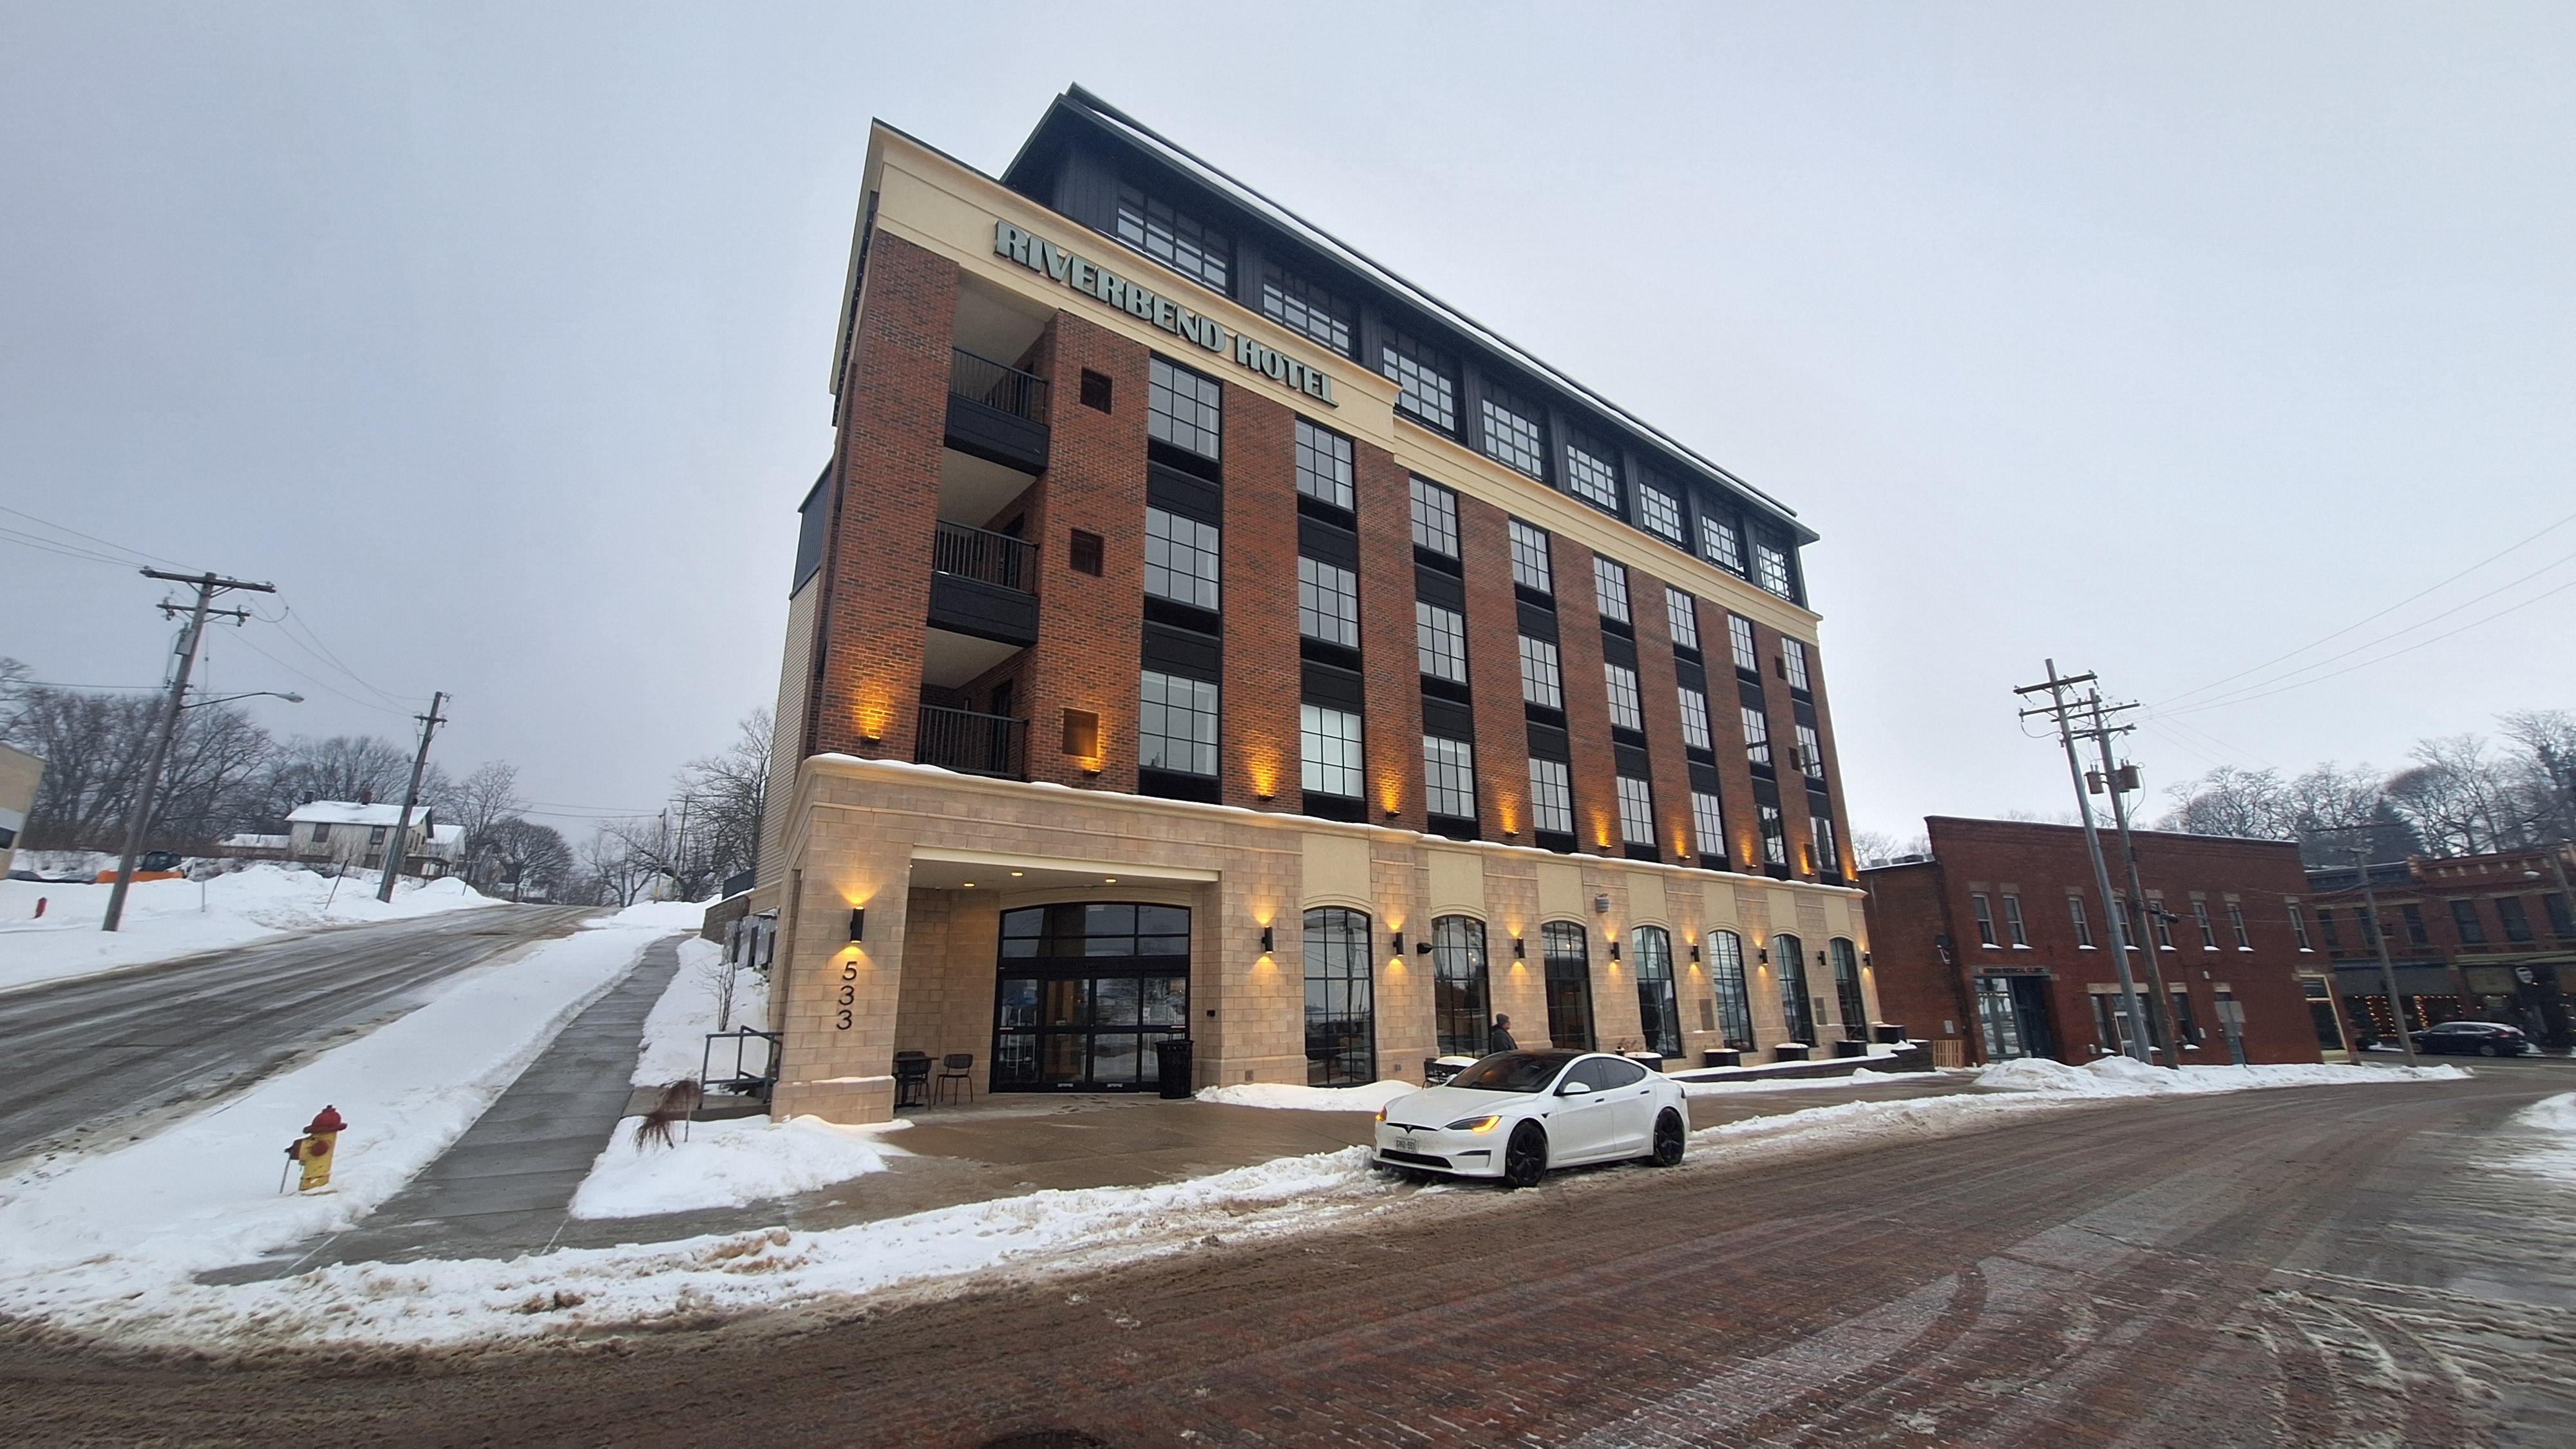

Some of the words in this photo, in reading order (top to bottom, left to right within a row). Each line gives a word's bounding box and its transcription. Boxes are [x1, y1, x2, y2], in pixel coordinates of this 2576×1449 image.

[994, 220, 1226, 353] RIVERBEND
[1235, 333, 1339, 408] HOTEL
[837, 961, 857, 1030] 533
